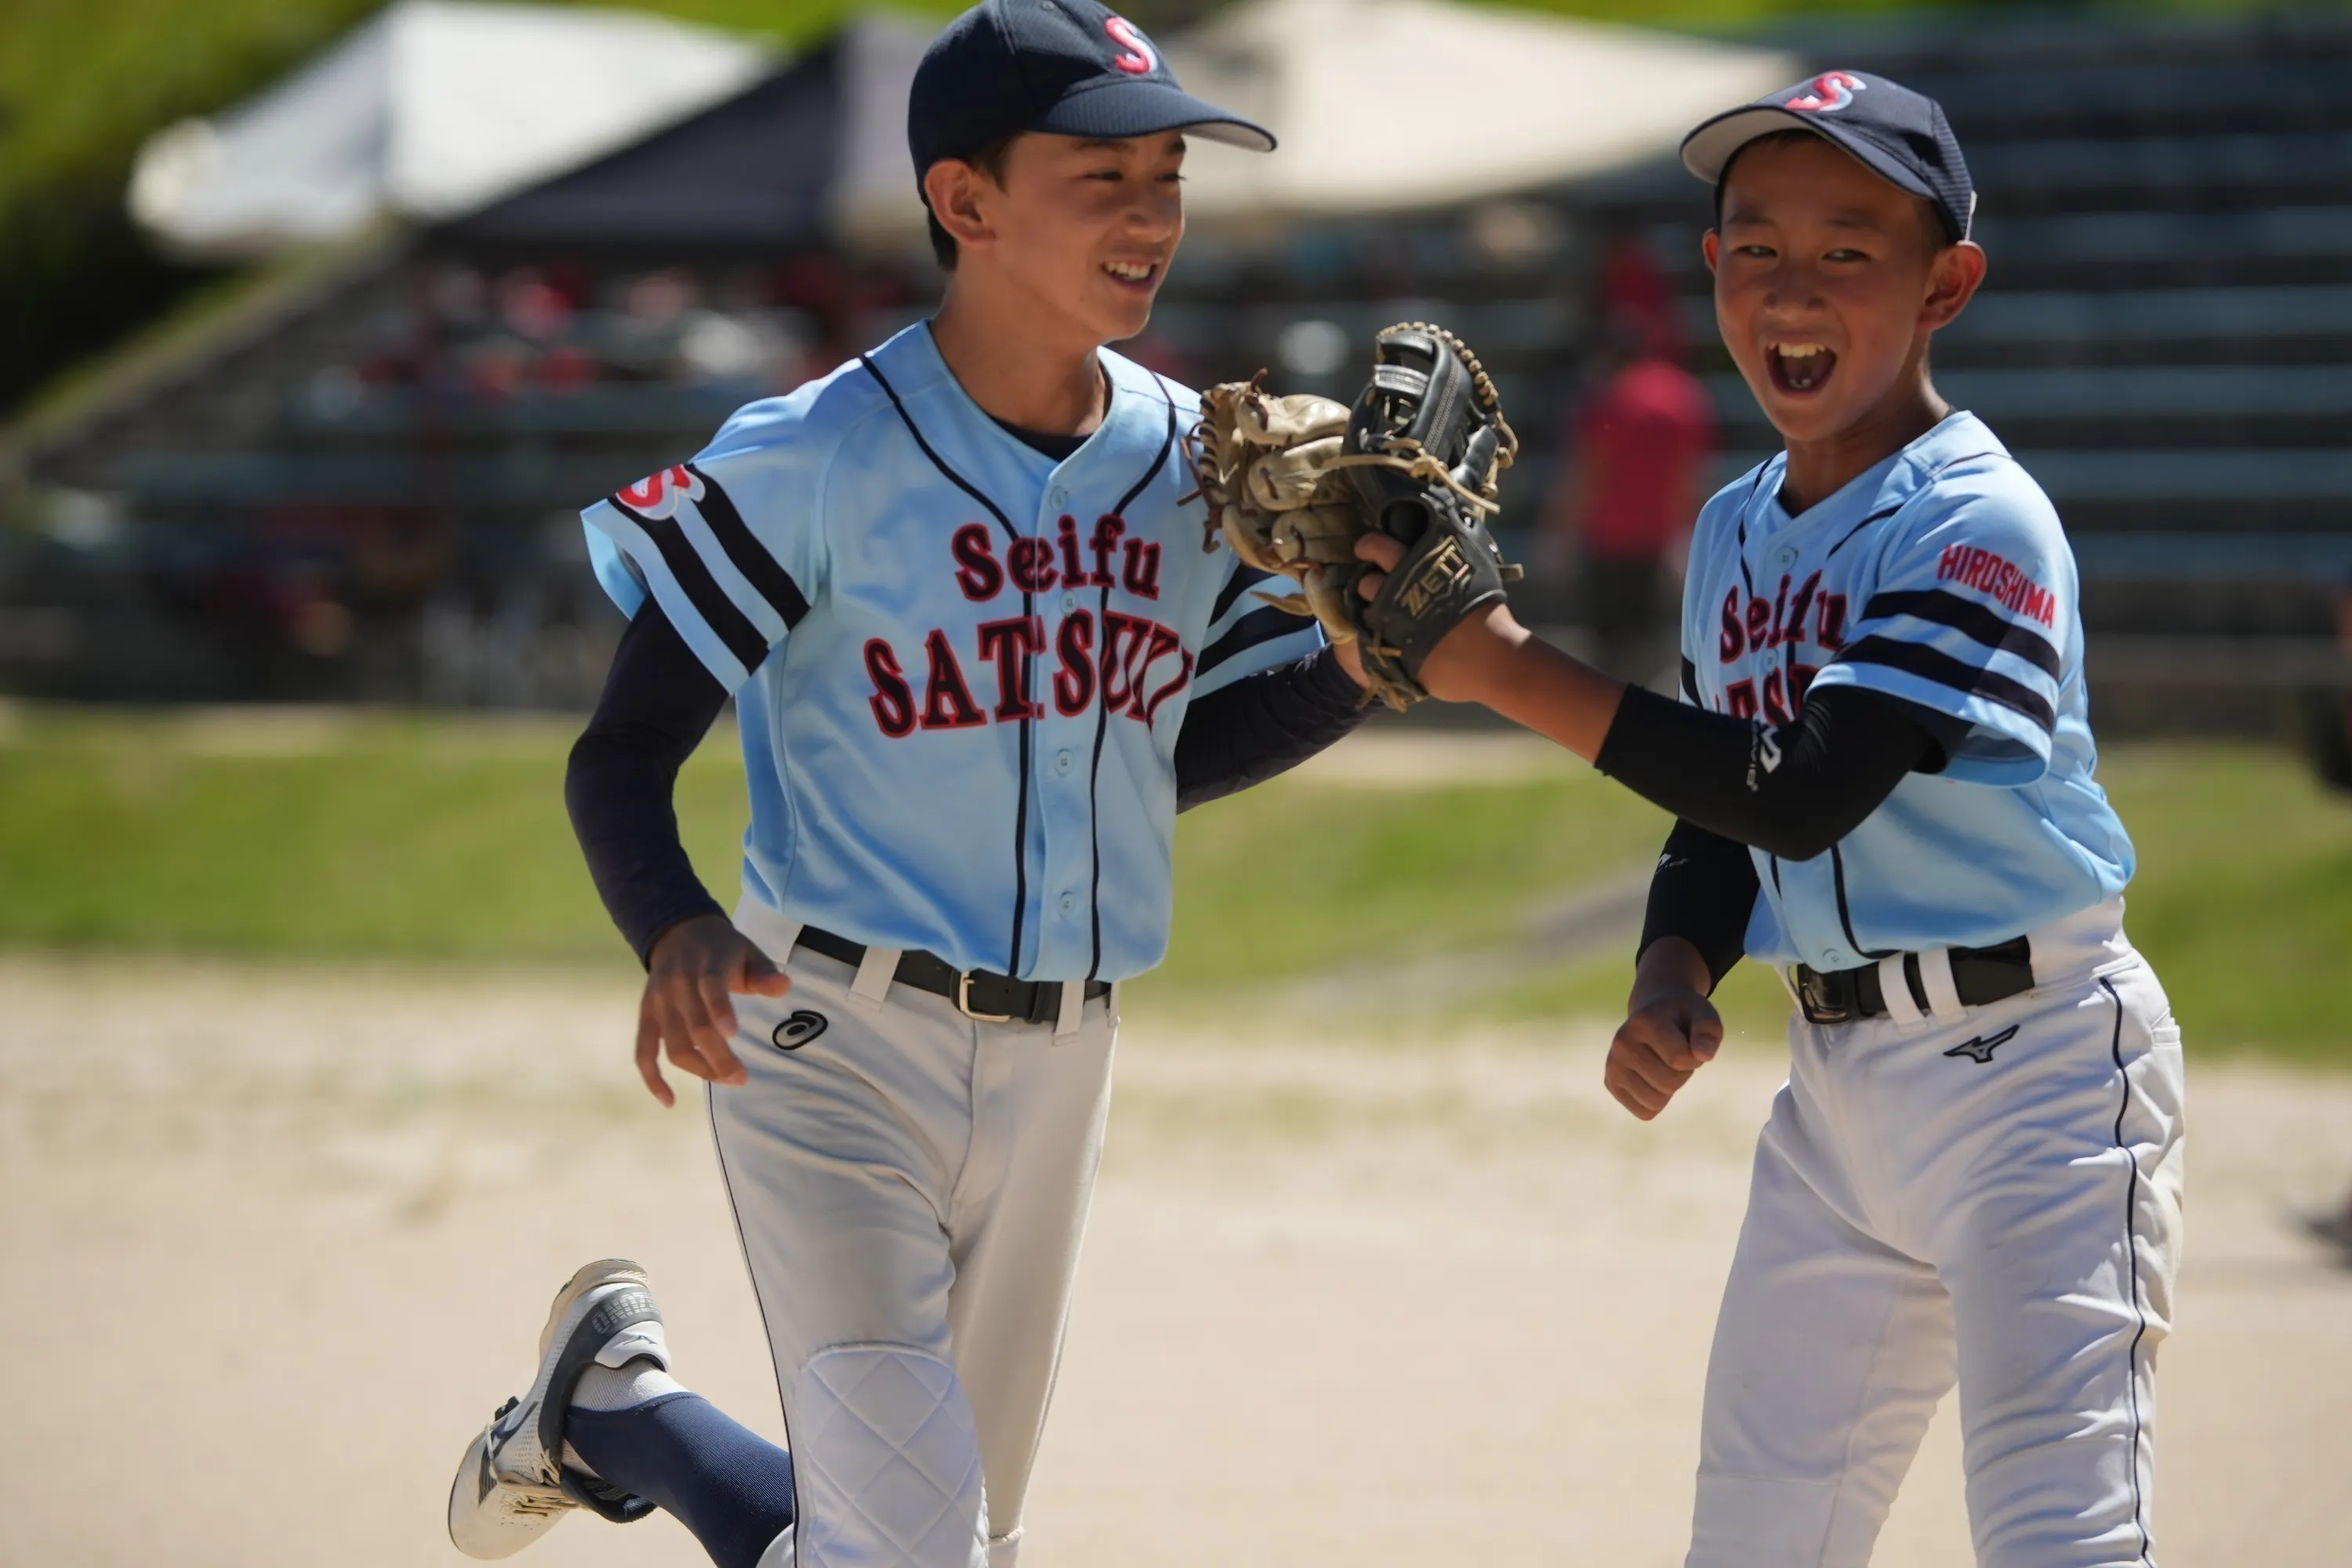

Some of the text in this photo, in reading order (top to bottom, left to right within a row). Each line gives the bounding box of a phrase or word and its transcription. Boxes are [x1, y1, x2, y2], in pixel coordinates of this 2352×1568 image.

[1105, 16, 1158, 74] S
[1784, 71, 1867, 111] S
[952, 514, 1160, 601] Seifu
[1400, 544, 1457, 616] ZETT
[1936, 544, 2056, 630] HIROSHIMA
[1720, 570, 1846, 663] Seifu
